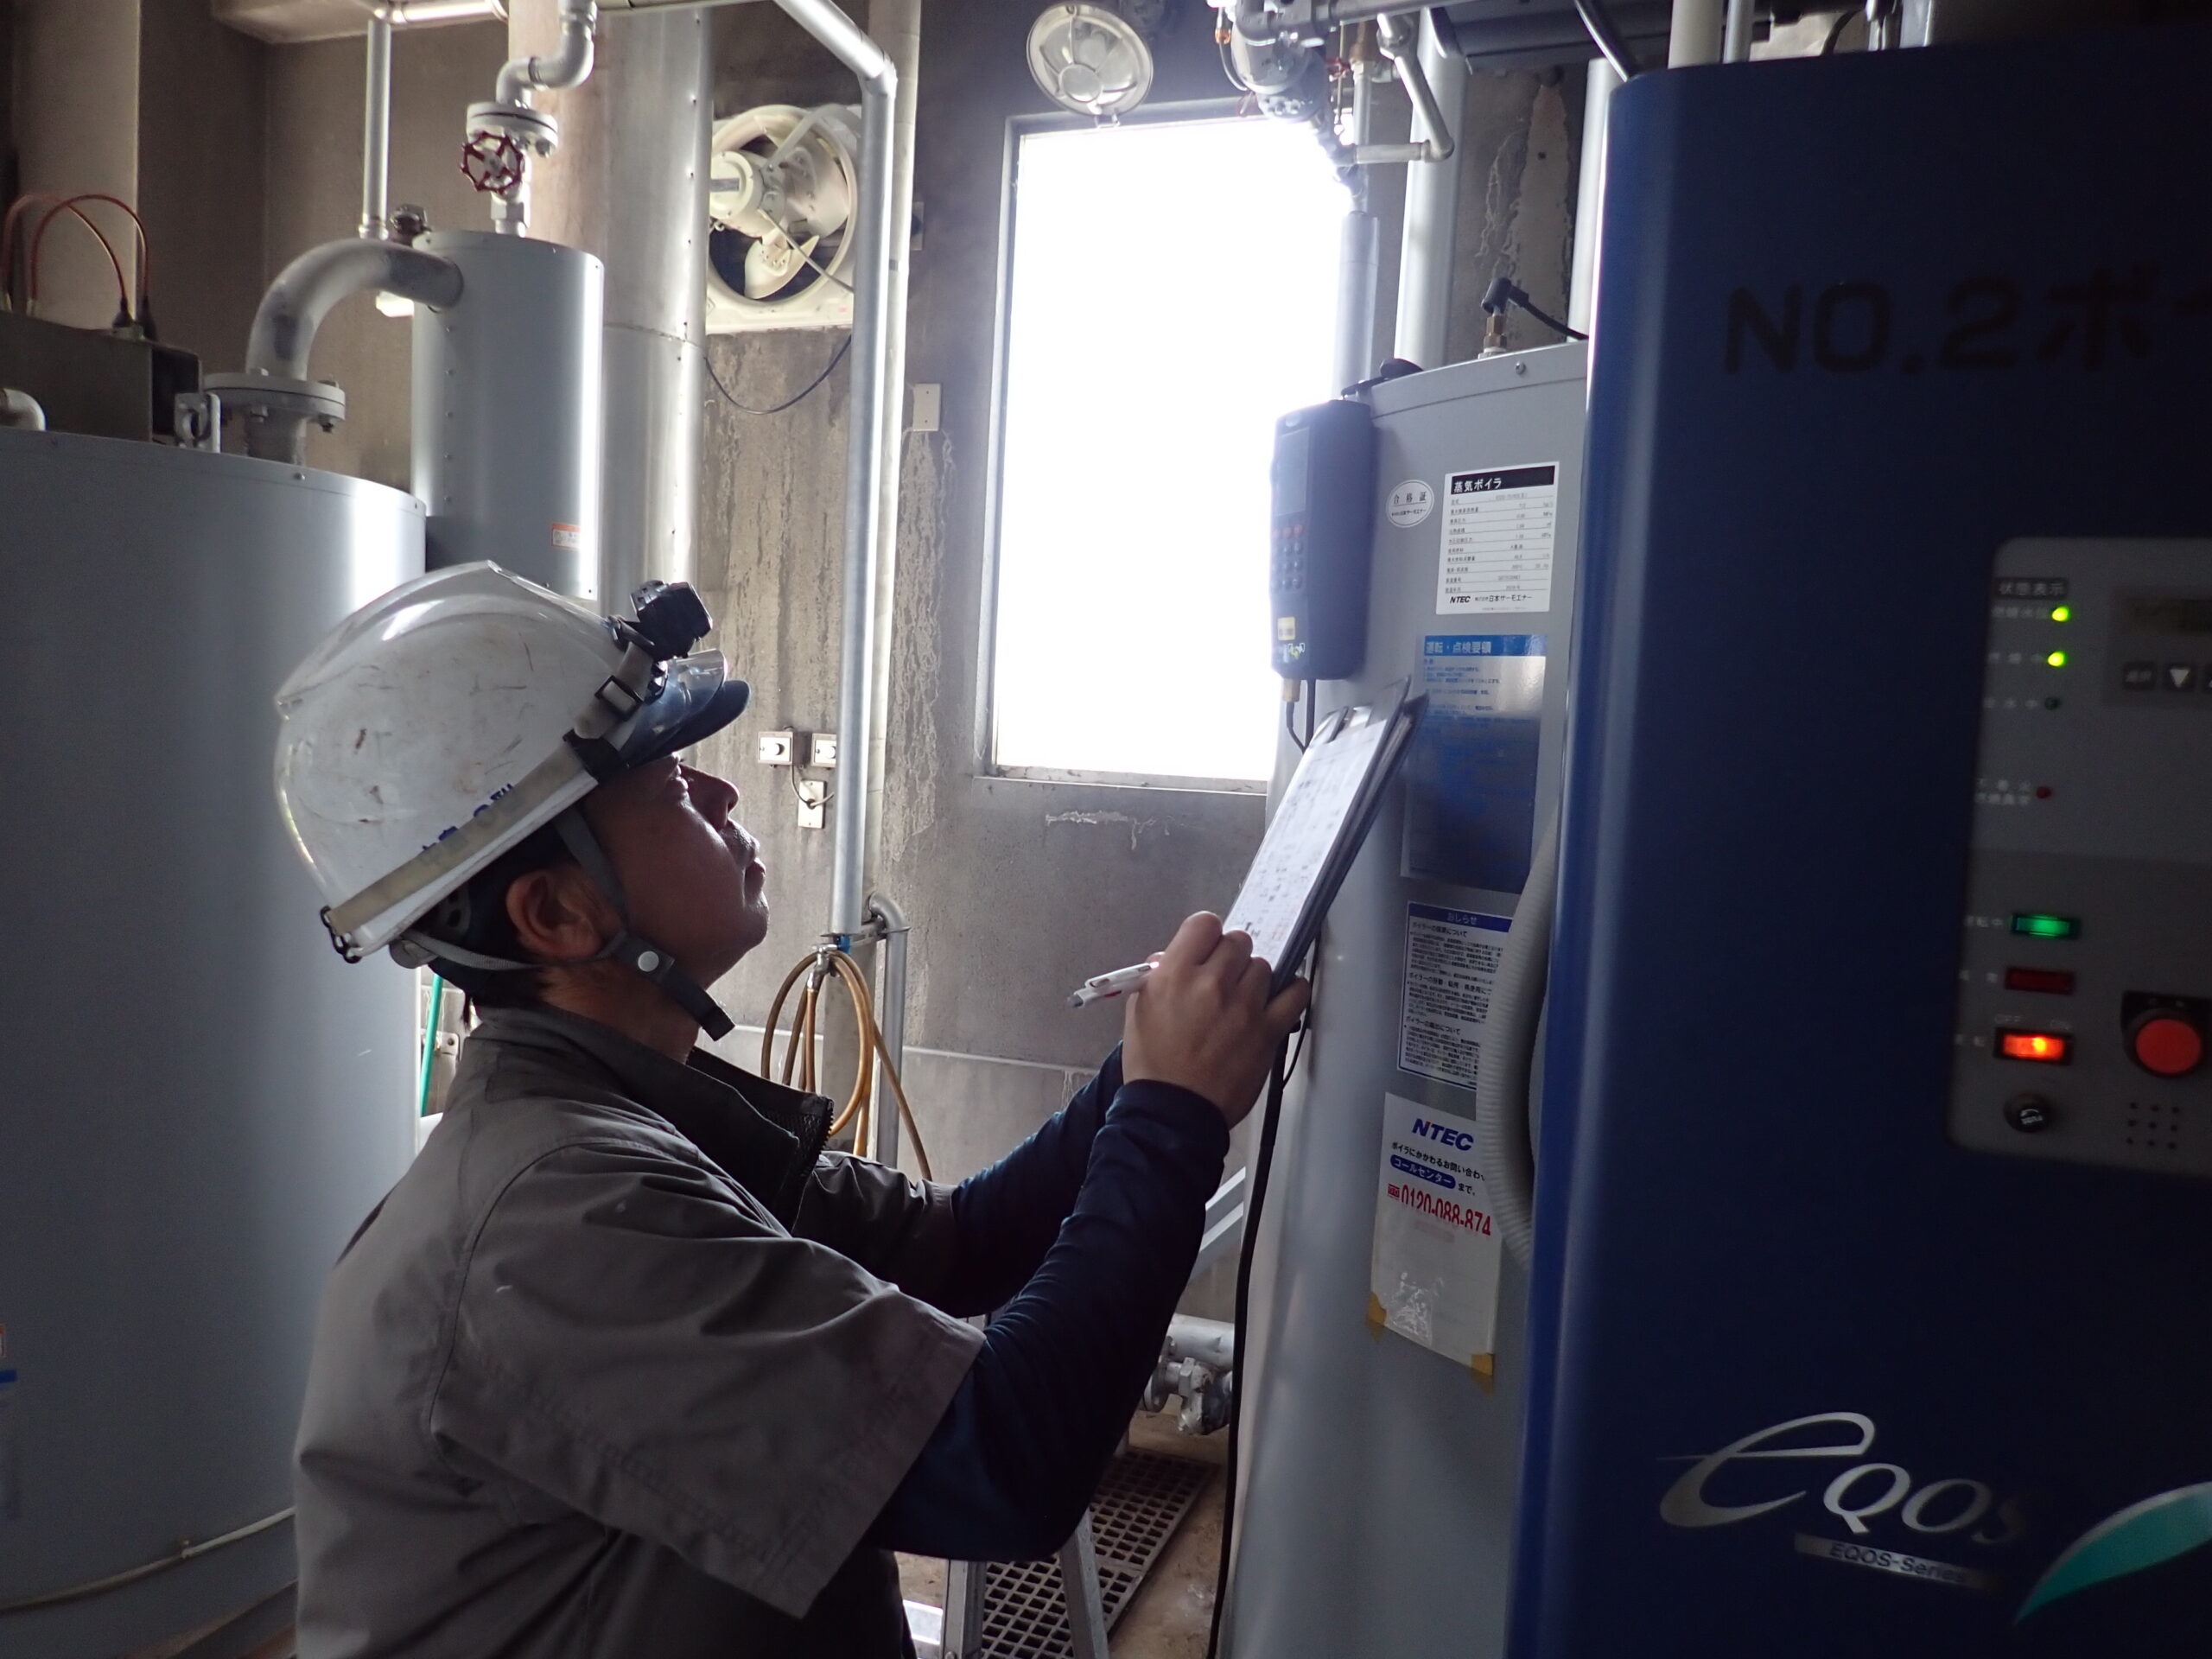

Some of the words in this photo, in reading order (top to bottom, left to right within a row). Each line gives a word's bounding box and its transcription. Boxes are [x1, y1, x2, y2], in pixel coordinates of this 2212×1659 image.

[1453, 478, 1502, 493] 蒸気ボイラ
[1449, 595, 1471, 604] NTEC
[1446, 912, 1478, 925] おしらせ
[1412, 1118, 1474, 1151] NTEC
[1394, 1157, 1452, 1184] コールセンター
[1829, 1541, 1968, 1584] EQOS-Series
